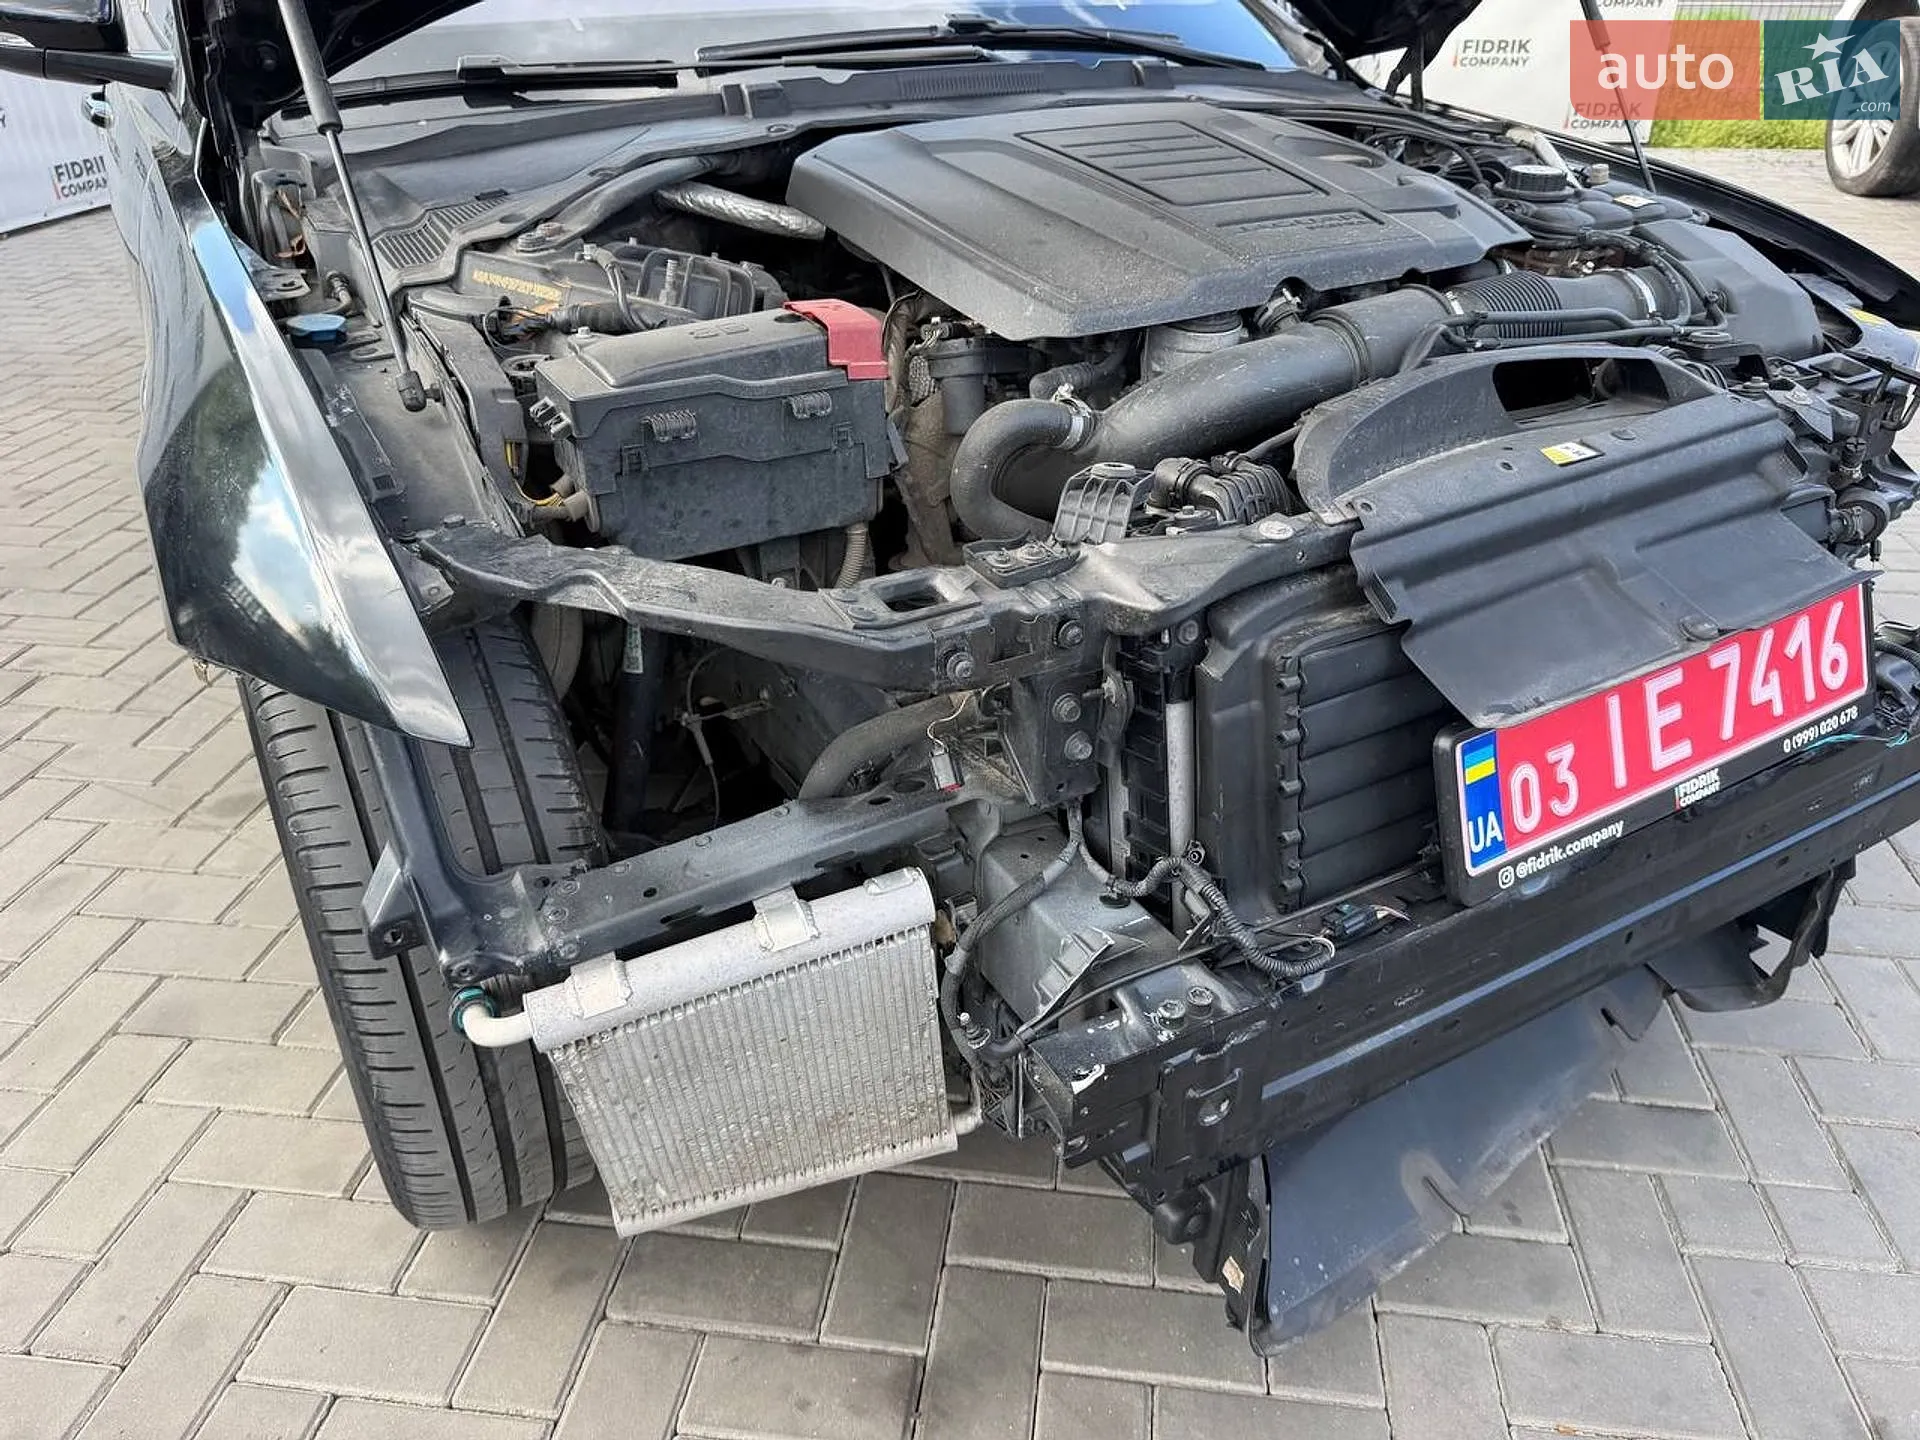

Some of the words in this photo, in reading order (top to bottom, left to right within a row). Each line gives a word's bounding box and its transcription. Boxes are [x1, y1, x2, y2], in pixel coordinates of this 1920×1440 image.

[1463, 39, 1532, 53] FIDRIK
[1460, 56, 1530, 67] COMPANY
[1574, 102, 1642, 116] FIDRK
[1510, 740, 1580, 834] 03
[1607, 667, 1693, 789] IE
[1708, 600, 1849, 741] 7416
[1792, 725, 1819, 748] (999)
[1679, 768, 1720, 797] FIDRIK
[1680, 782, 1720, 807] COMPANY
[1468, 811, 1503, 853] UA
[1516, 820, 1625, 879] @fidrik.company
